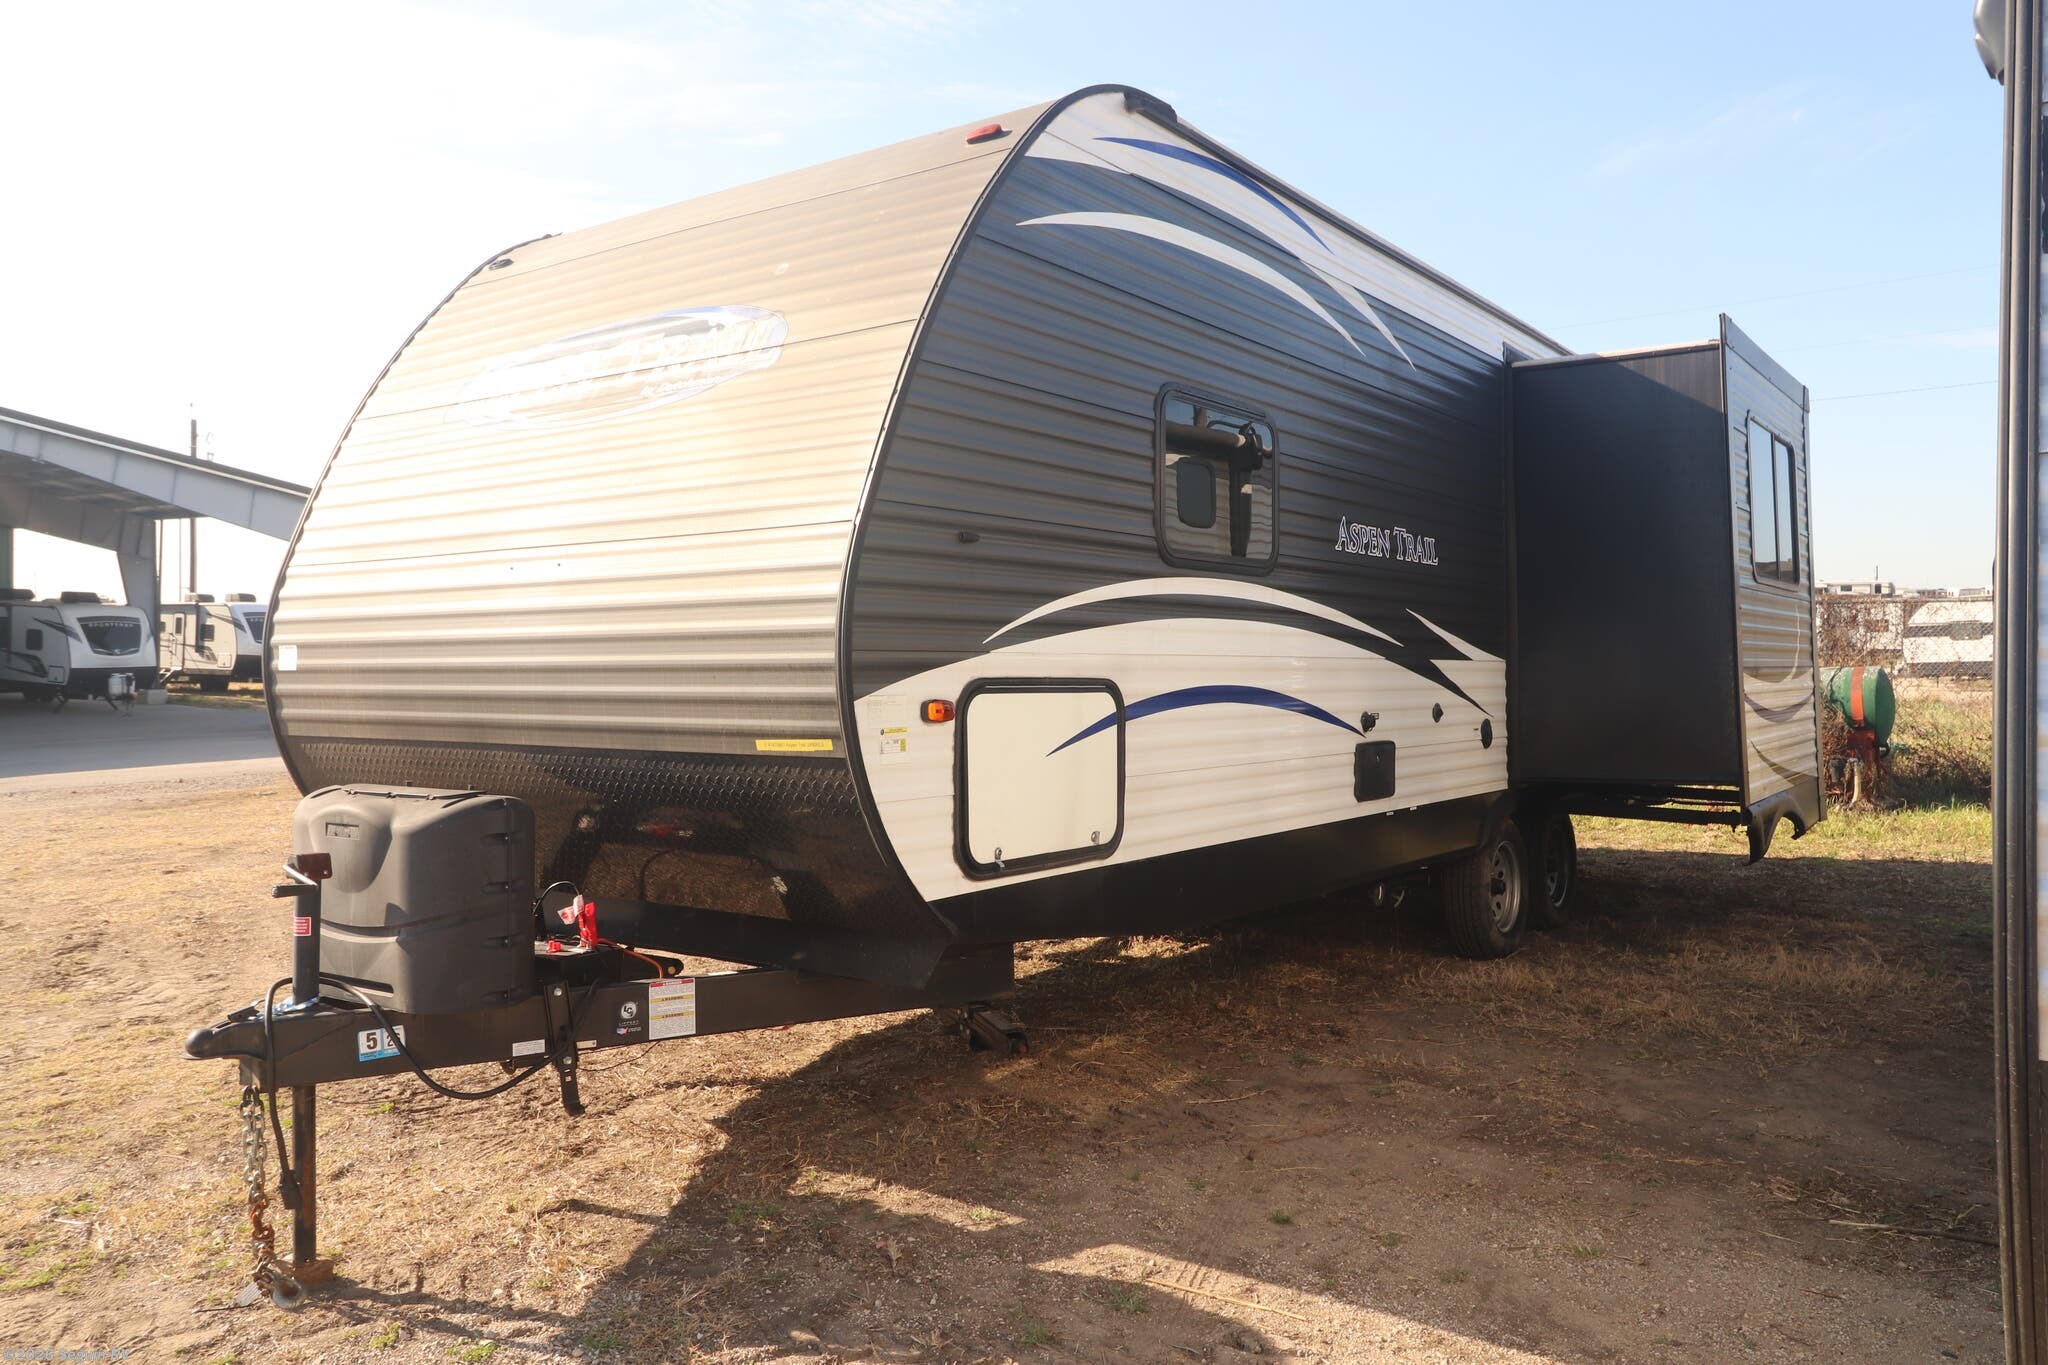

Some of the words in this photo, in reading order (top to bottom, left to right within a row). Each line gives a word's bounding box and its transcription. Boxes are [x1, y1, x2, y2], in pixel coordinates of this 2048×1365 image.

[1335, 515, 1391, 559] ASPEN
[1393, 526, 1439, 566] TRAIL
[367, 1032, 377, 1050] 5
